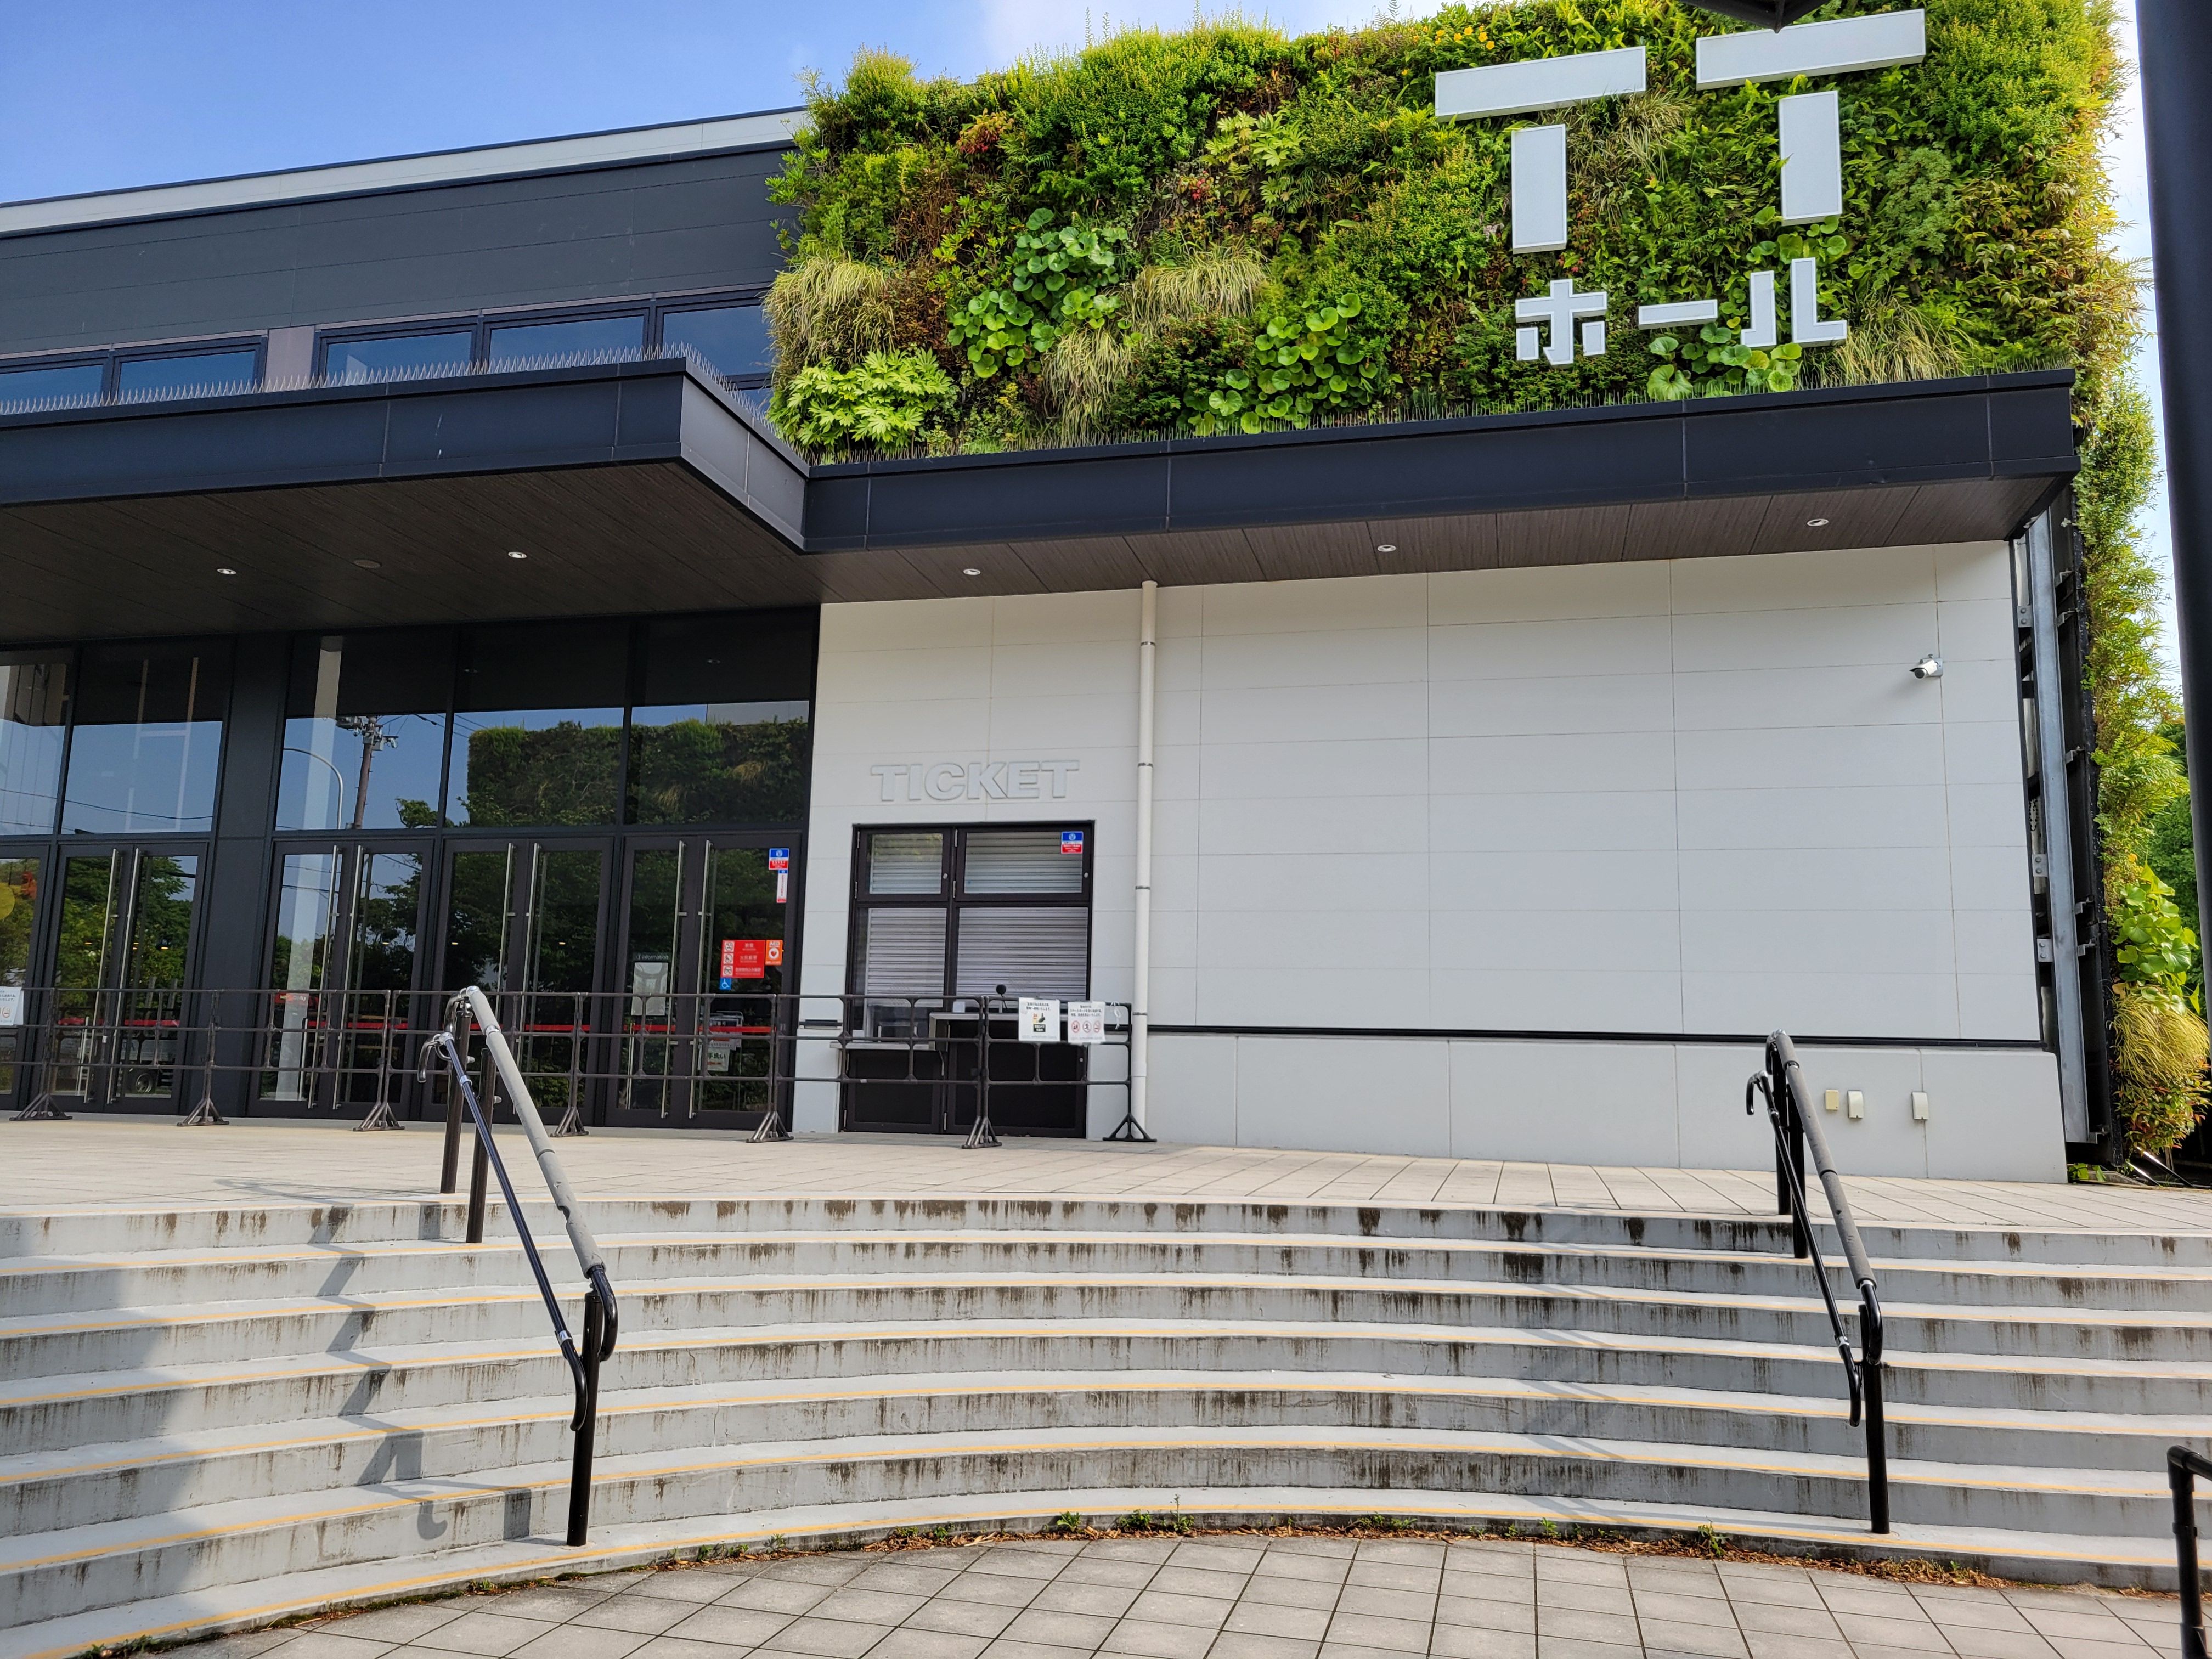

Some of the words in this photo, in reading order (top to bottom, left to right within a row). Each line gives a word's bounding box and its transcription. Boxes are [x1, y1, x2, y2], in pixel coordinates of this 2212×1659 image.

[1515, 257, 1848, 368] ホール
[871, 760, 1080, 802] TICKET
